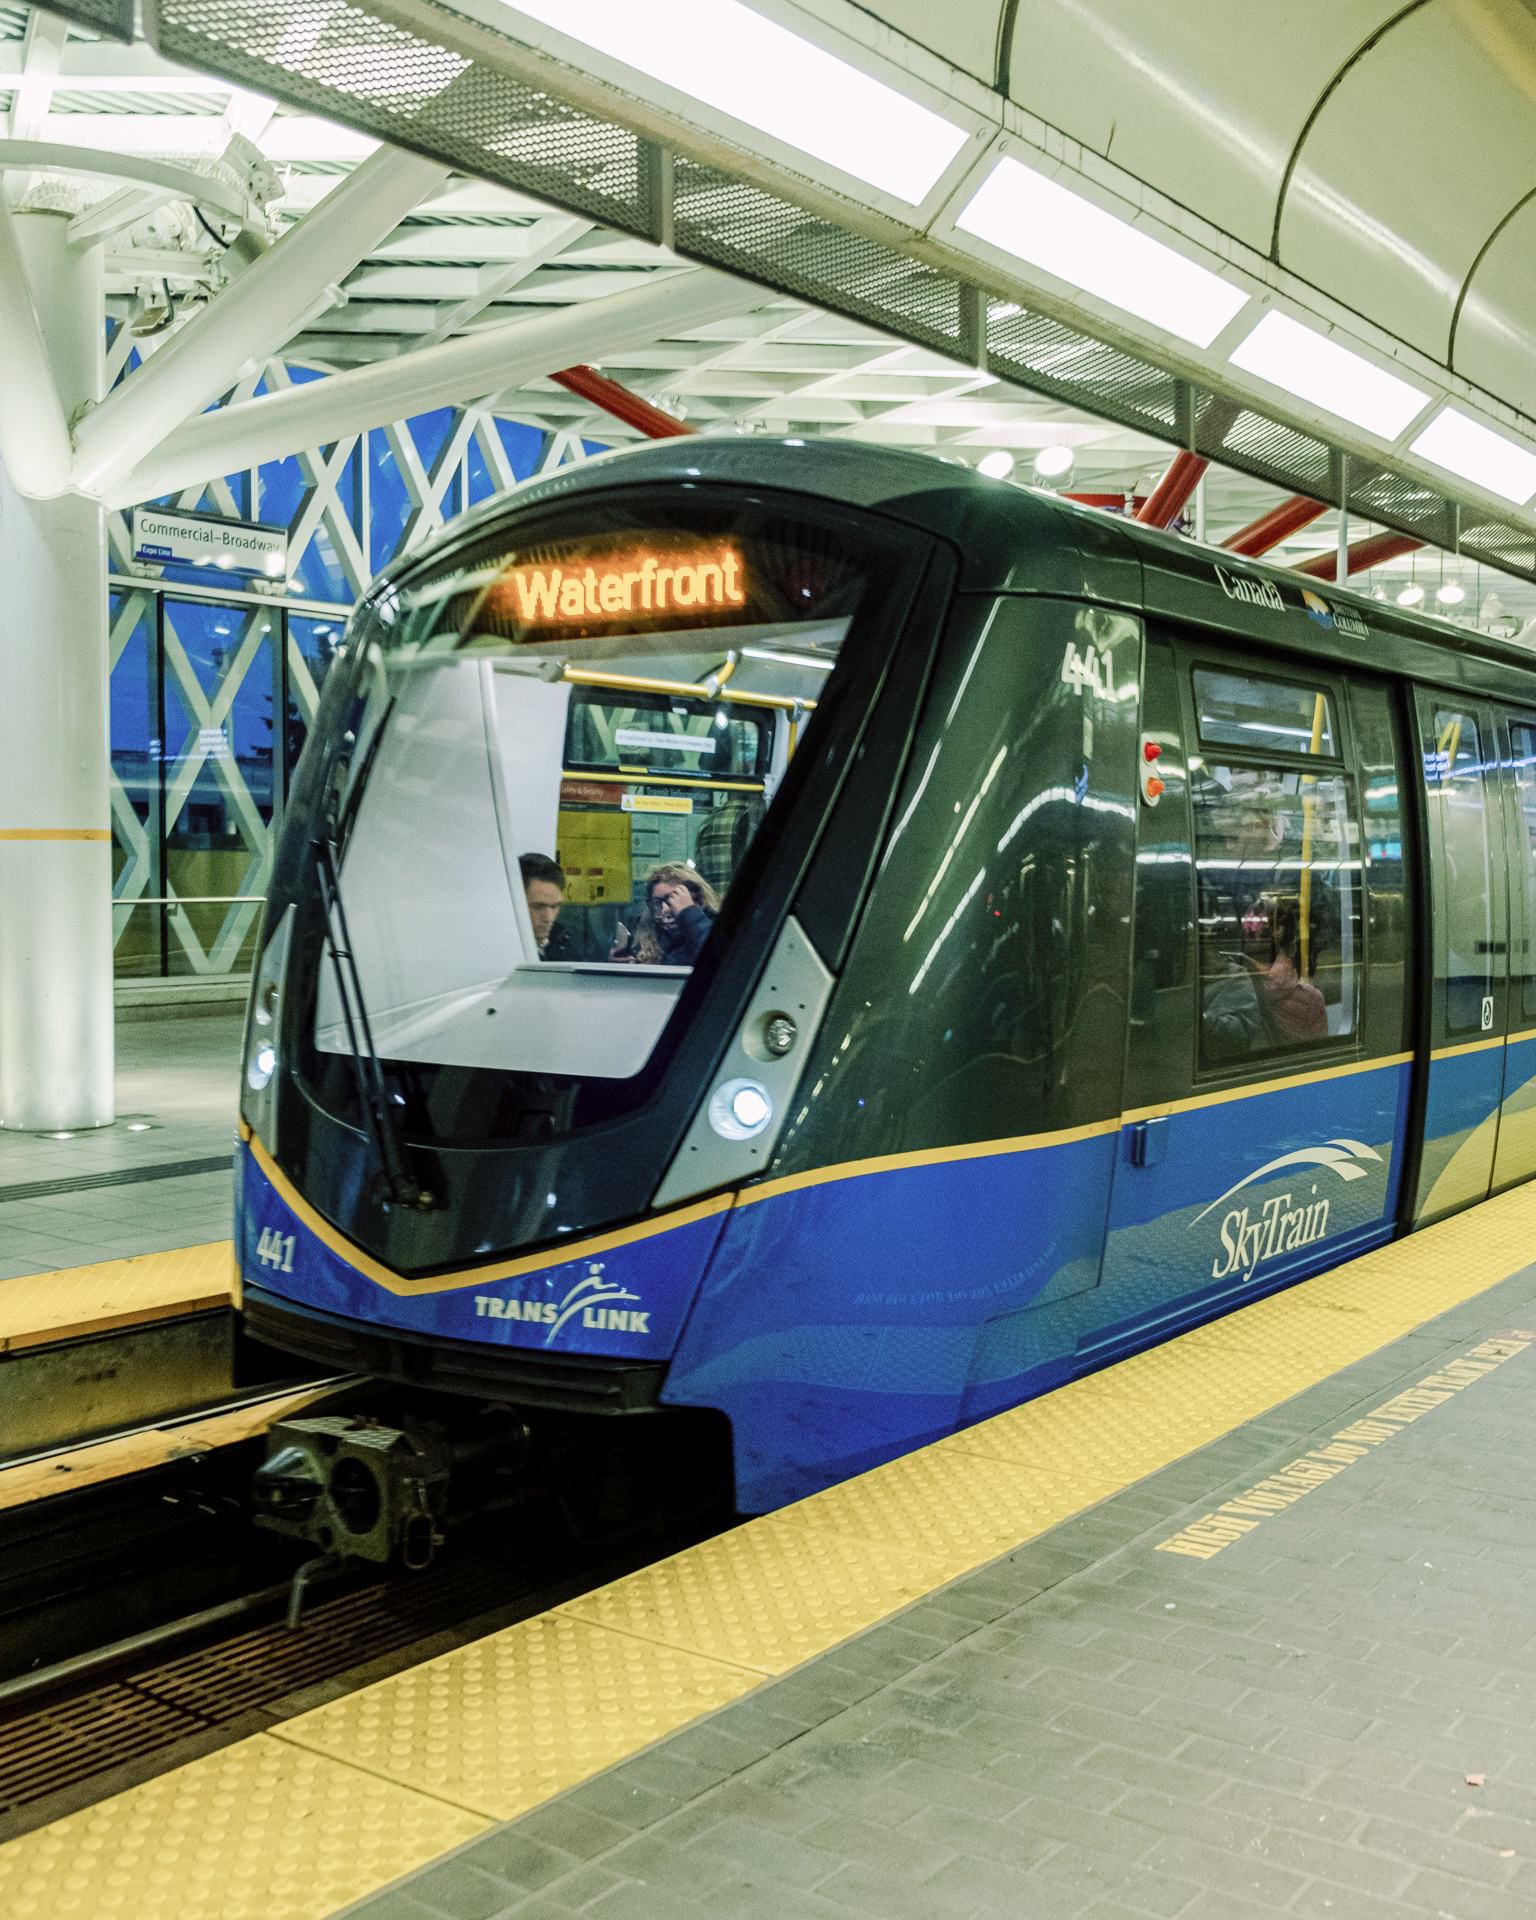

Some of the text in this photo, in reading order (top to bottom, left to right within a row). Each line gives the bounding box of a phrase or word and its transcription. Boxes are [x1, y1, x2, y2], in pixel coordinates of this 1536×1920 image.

[140, 518, 281, 553] Commercial-Broadway
[514, 551, 743, 621] Waterfront
[1213, 563, 1287, 613] Canada
[1061, 641, 1117, 702] 441
[255, 1226, 297, 1273] 441
[1211, 1183, 1330, 1282] SkyTrain
[1153, 1512, 1261, 1561] HIGH
[1216, 1458, 1347, 1518] VOLTAGE
[1330, 1418, 1406, 1447] NOT
